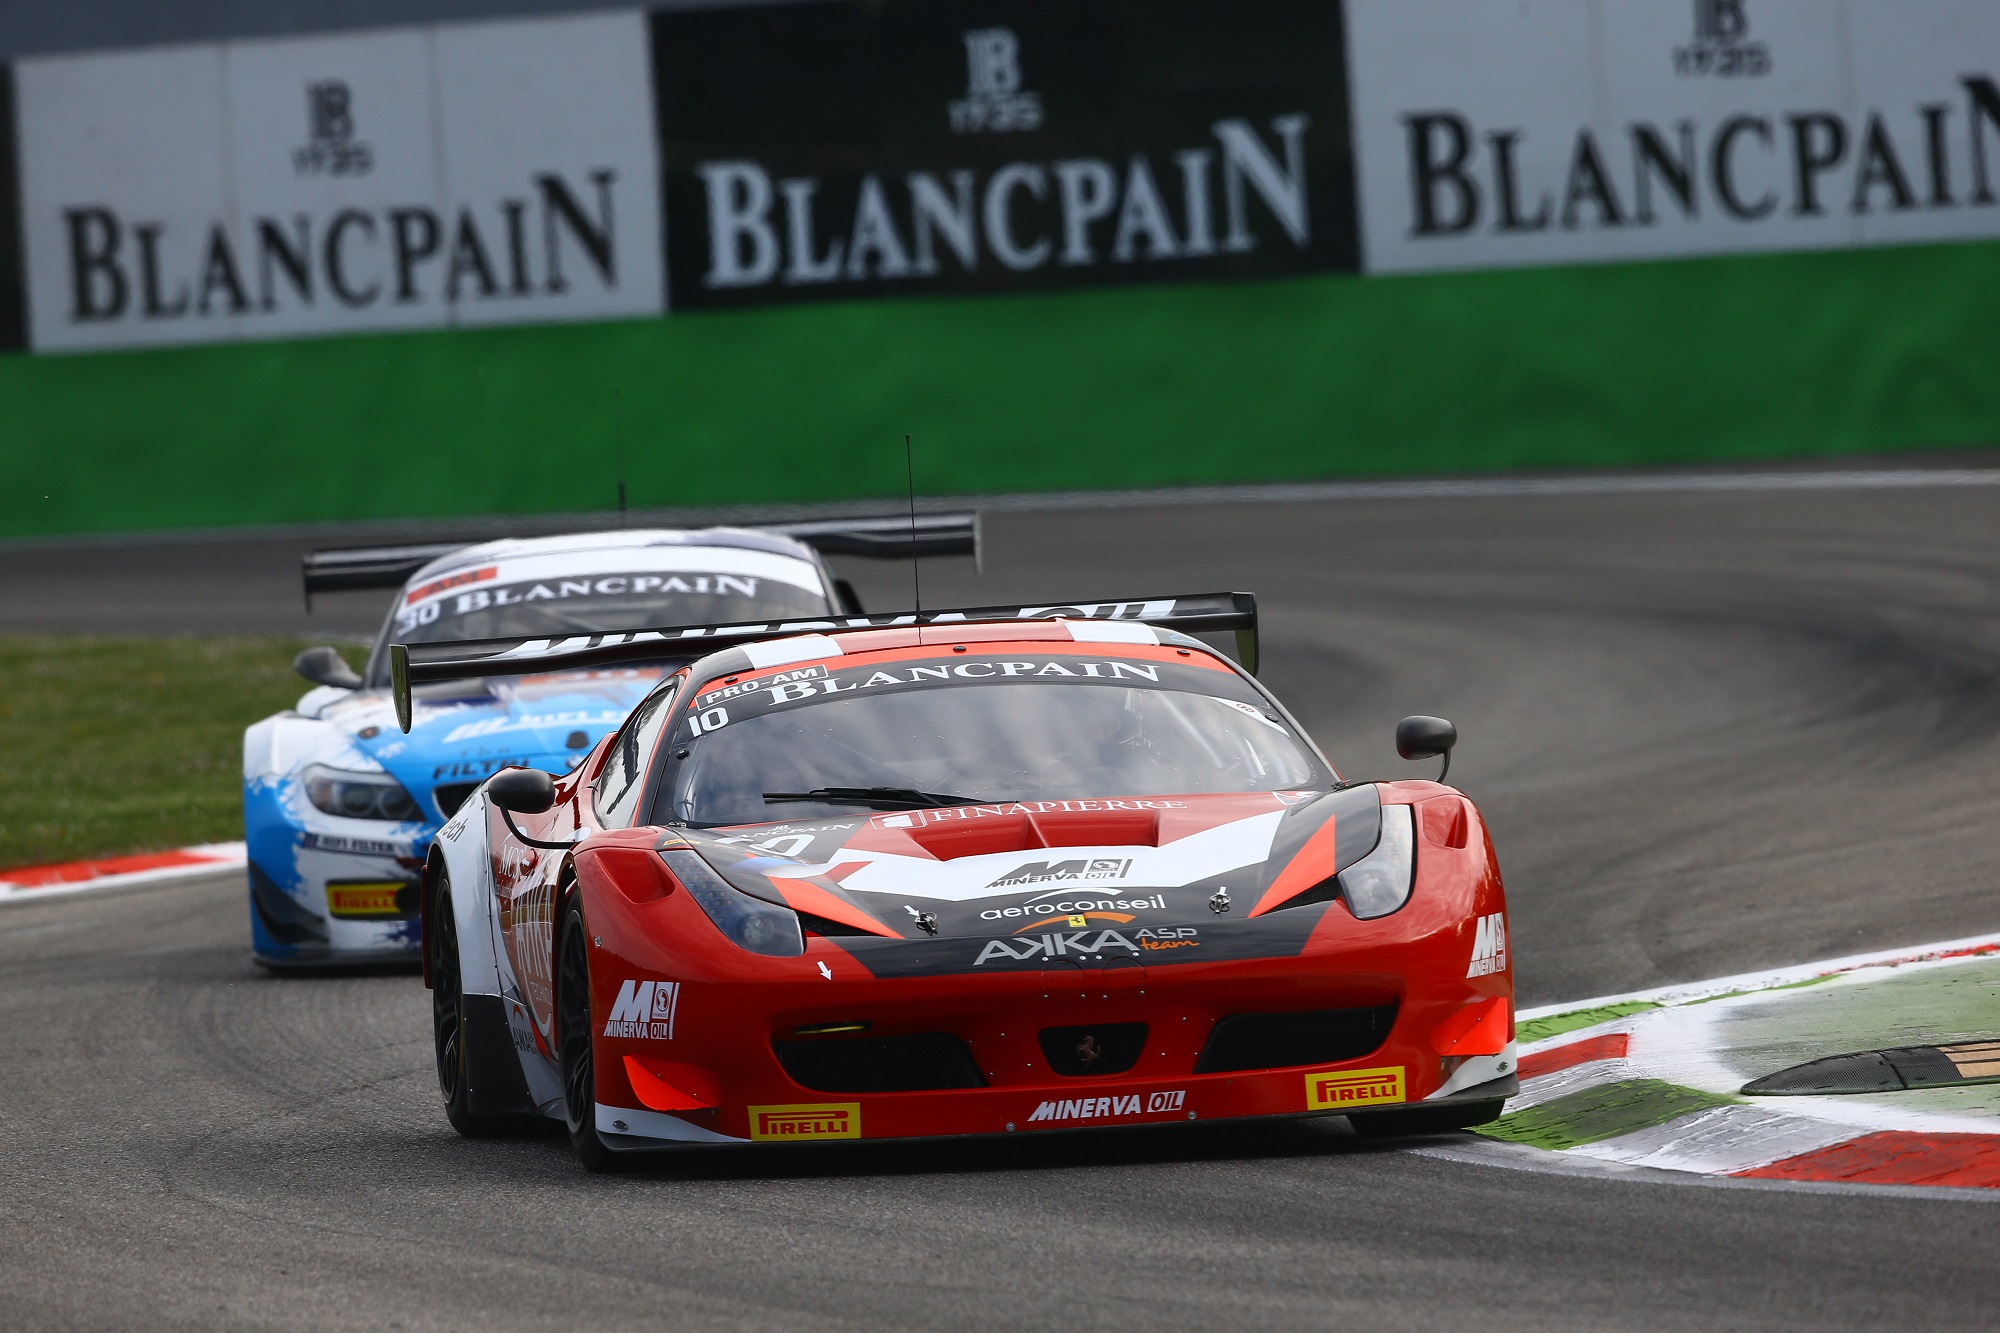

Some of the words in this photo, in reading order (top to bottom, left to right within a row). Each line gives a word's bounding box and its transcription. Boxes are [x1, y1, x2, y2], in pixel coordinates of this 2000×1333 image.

[696, 114, 1310, 287] BLANCPAIN
[62, 168, 618, 324] BLANCPAIN
[455, 574, 759, 614] BLANCPAIN
[706, 668, 817, 704] PRO-AM
[763, 661, 1160, 706] BLANCPAIN
[688, 707, 729, 738] 10
[932, 800, 1187, 822] FINAPIERRE
[737, 823, 856, 838] ANCPAIN
[984, 873, 1080, 889] MINERVA
[1086, 872, 1117, 880] OIL
[980, 894, 1166, 920] aeroconseil
[1134, 928, 1198, 939] ASP
[1140, 937, 1200, 951] team
[603, 1021, 649, 1038] MINERVA
[651, 1023, 667, 1039] OIL
[1316, 1073, 1397, 1103] PIRELLI
[1028, 1094, 1141, 1121] MINERVA
[1149, 1091, 1184, 1112] OIL
[758, 1110, 848, 1135] PIRELLI
